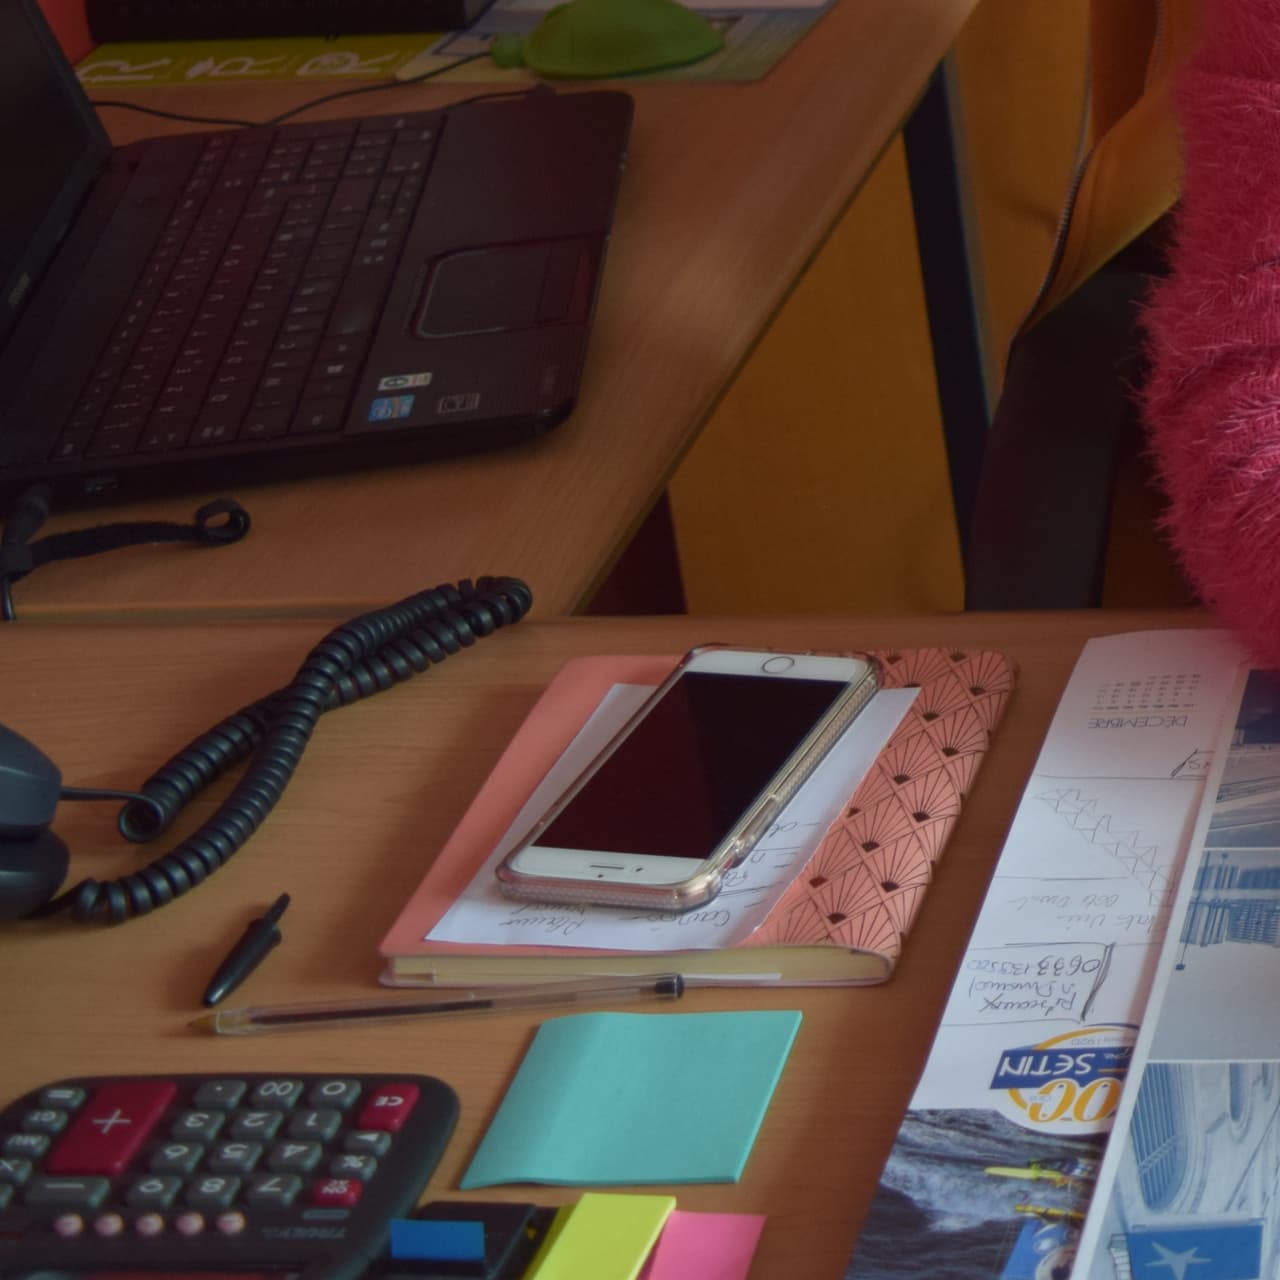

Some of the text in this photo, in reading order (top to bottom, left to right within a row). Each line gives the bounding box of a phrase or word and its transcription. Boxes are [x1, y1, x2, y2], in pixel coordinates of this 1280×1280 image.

[997, 1052, 1097, 1077] SETIN
[259, 1081, 293, 1098] 00
[374, 1095, 405, 1109] CE
[184, 1112, 209, 1129] 3
[240, 1112, 270, 1129] 2
[306, 1112, 320, 1128] 1
[162, 1145, 189, 1162] 6
[221, 1143, 248, 1161] 5
[282, 1143, 309, 1160] 4
[137, 1178, 164, 1195] 9
[199, 1177, 228, 1194] 8
[257, 1176, 286, 1193] 7
